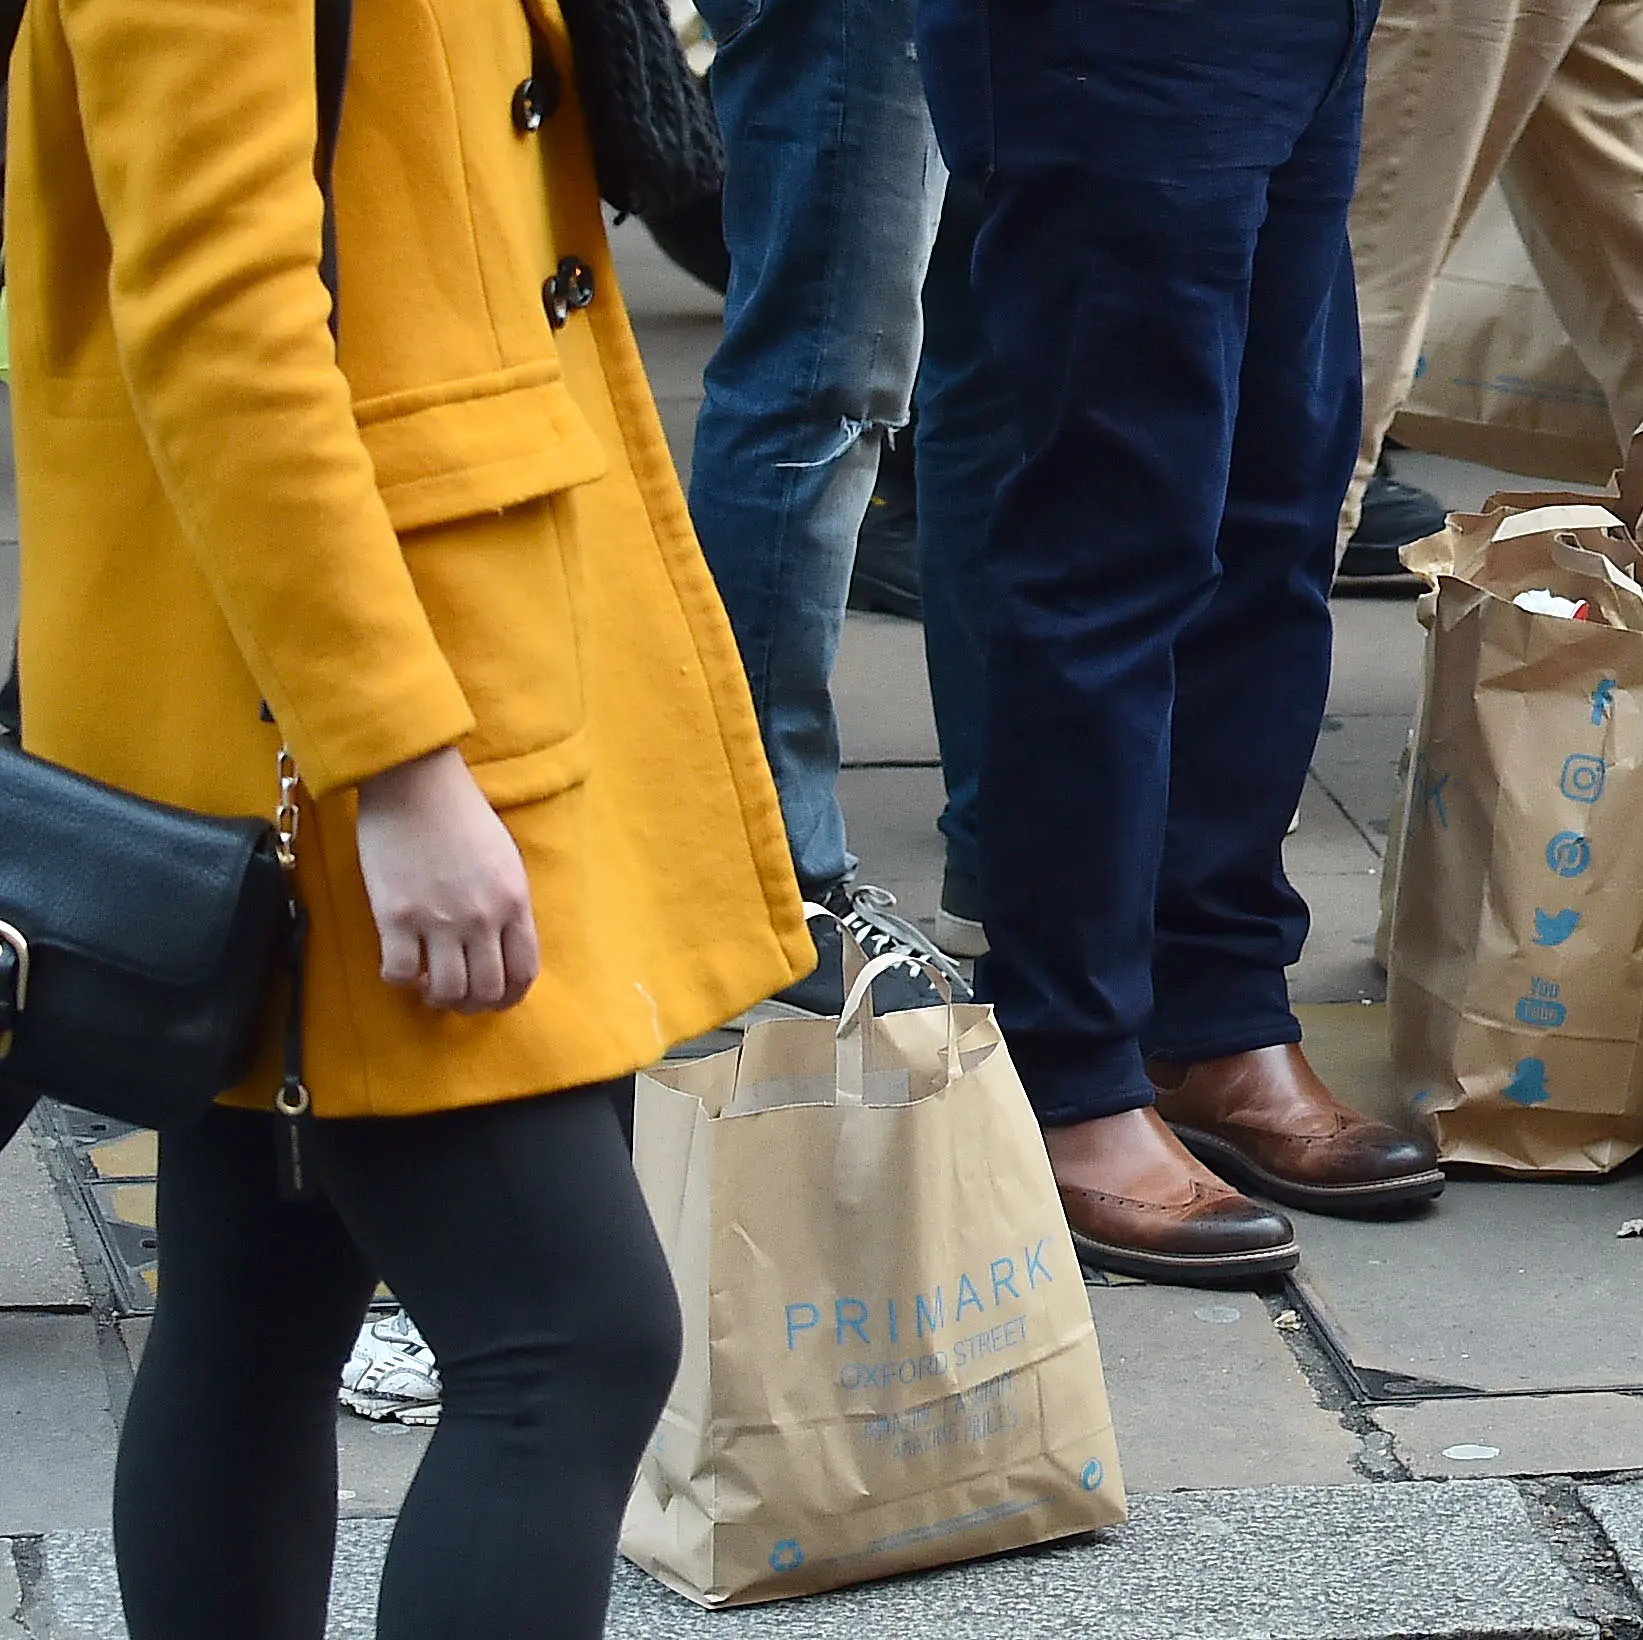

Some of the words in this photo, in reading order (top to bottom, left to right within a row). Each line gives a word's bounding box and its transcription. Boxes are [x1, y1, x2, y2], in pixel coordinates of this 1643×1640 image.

[784, 1239, 1053, 1350] PRIMARK
[840, 1350, 949, 1391] OXFORD
[952, 1314, 1028, 1367] STREET
